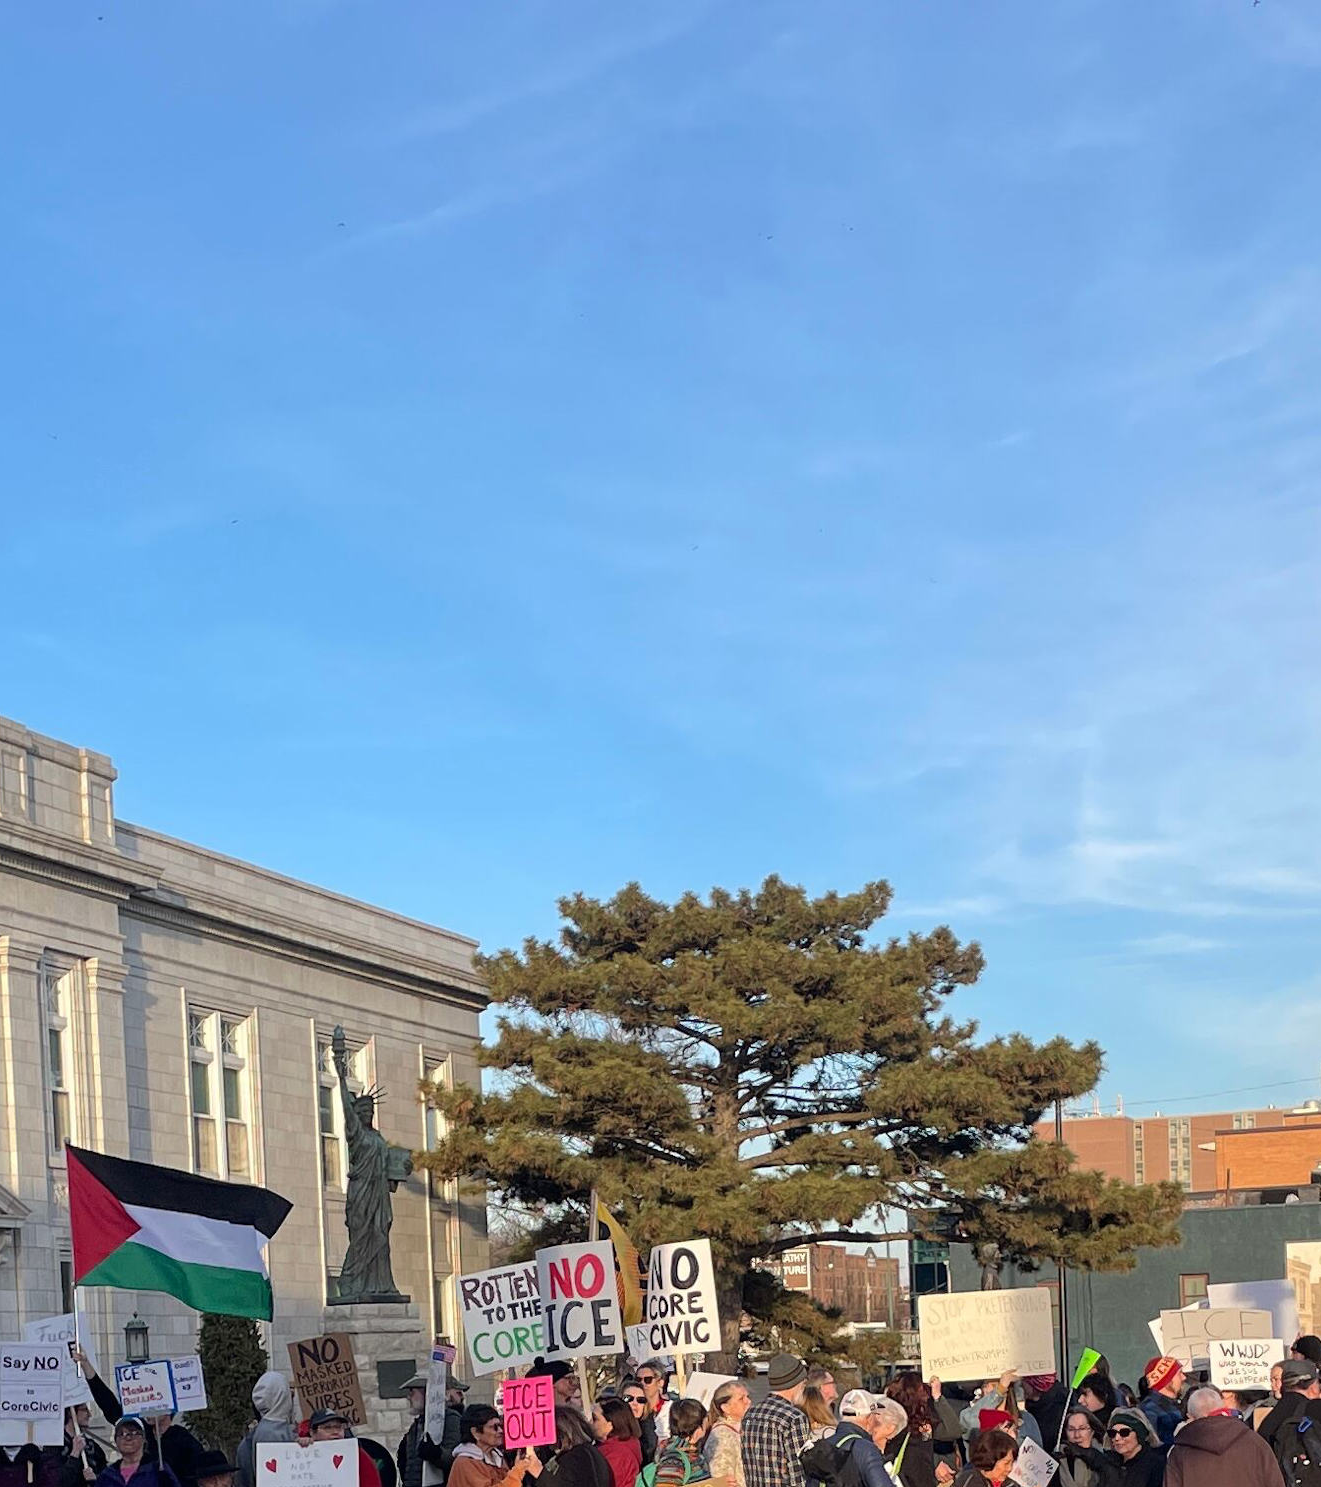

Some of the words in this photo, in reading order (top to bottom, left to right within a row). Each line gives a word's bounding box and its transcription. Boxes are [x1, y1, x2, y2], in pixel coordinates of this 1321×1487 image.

[548, 1253, 606, 1300] NO
[651, 1247, 699, 1291] NO
[460, 1265, 540, 1311] ROTTEN
[482, 1306, 507, 1325] TO
[507, 1299, 542, 1321] THE
[649, 1290, 704, 1321] CORE
[927, 1298, 966, 1325] STOP
[545, 1298, 616, 1354] ICE
[649, 1317, 710, 1350] CIVIC
[1167, 1311, 1265, 1340] ICE
[298, 1338, 340, 1369] NO
[473, 1323, 545, 1364] CORE
[1219, 1341, 1271, 1359] WWJD?
[3, 1356, 30, 1371] Say
[34, 1356, 60, 1370] NO
[119, 1367, 141, 1382] ICE
[297, 1360, 352, 1385] MASKED
[1228, 1367, 1259, 1376] JESUS
[300, 1374, 357, 1398] TERRORIST
[506, 1382, 547, 1412] ICE
[1, 1401, 59, 1412] CoreCivic
[306, 1389, 355, 1412] VIBES
[506, 1409, 552, 1441] OUT
[285, 1448, 322, 1460] LOVE
[291, 1461, 313, 1471] NOT
